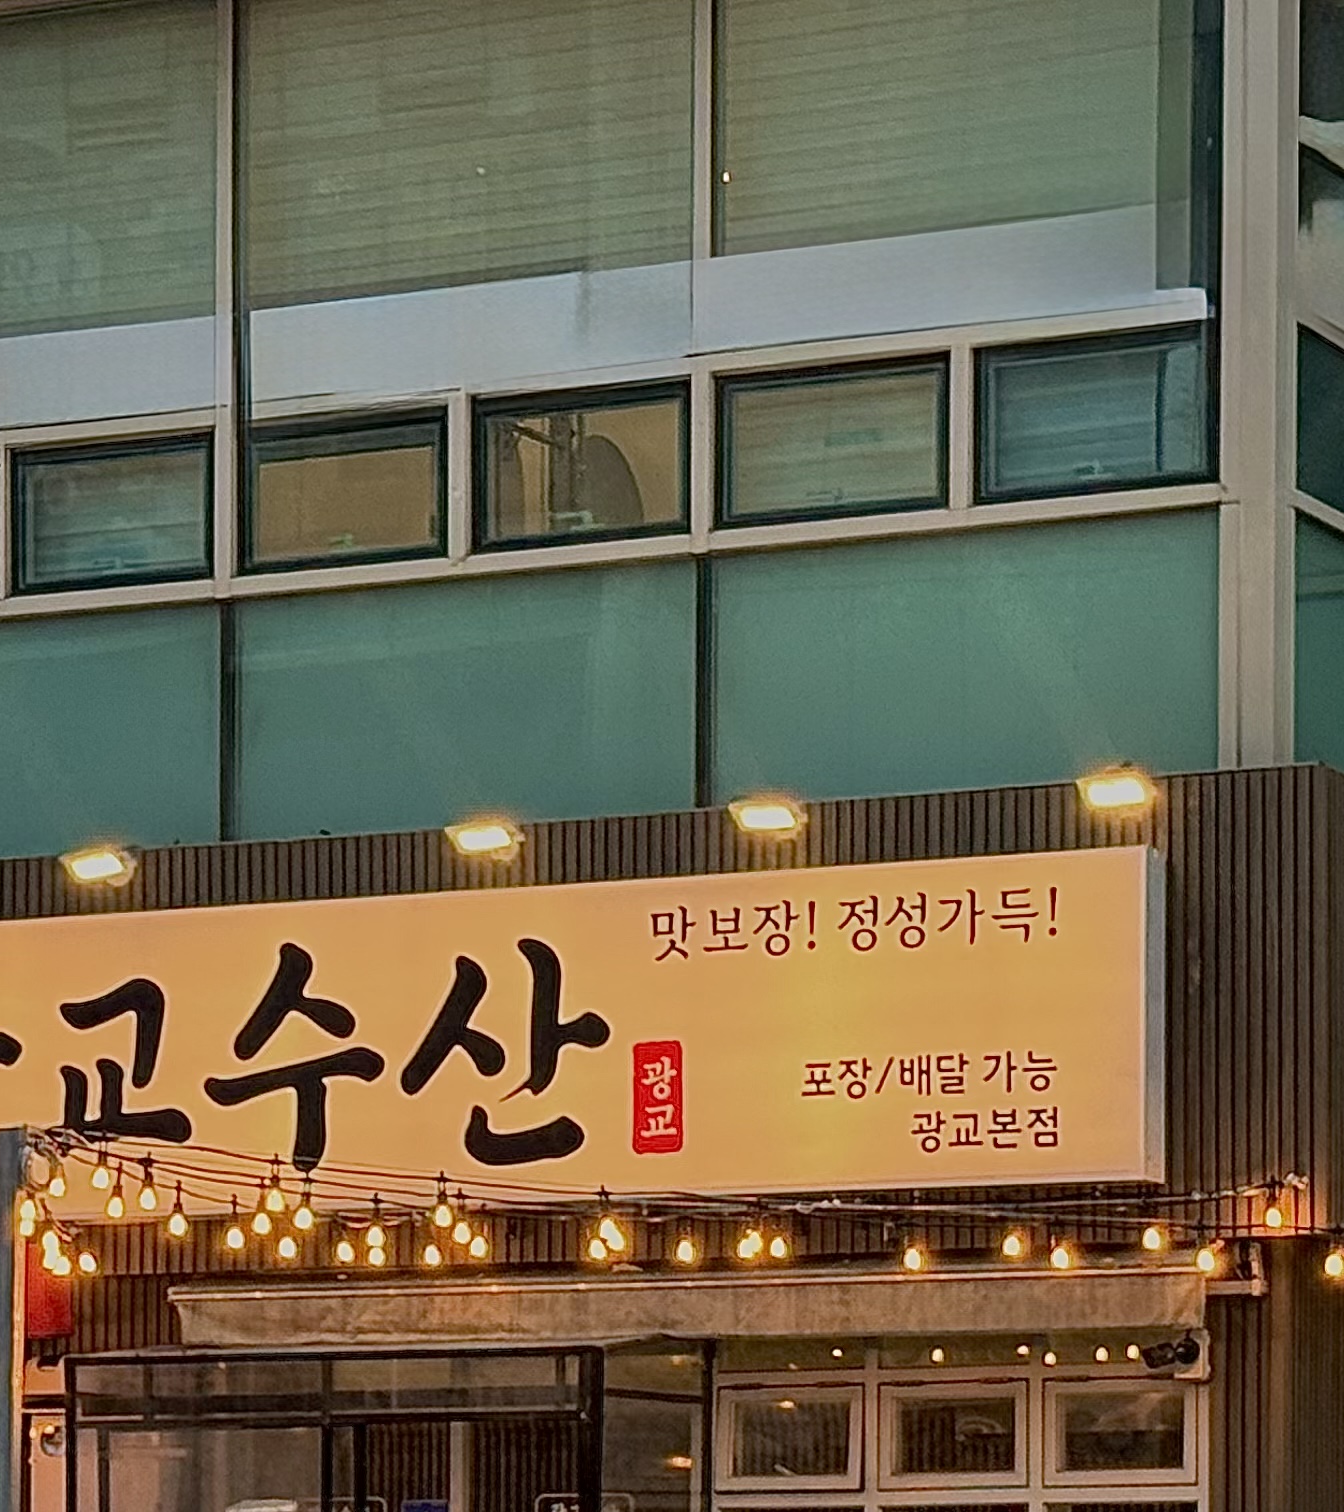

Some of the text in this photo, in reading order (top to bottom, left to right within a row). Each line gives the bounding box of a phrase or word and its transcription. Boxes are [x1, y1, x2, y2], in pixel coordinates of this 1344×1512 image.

[650, 886, 1058, 962] 맛보장! 정성가득!
[640, 1055, 678, 1138] 광교
[801, 1049, 1058, 1100] 포장/배달 가능
[910, 1105, 1058, 1154] 광교본점
